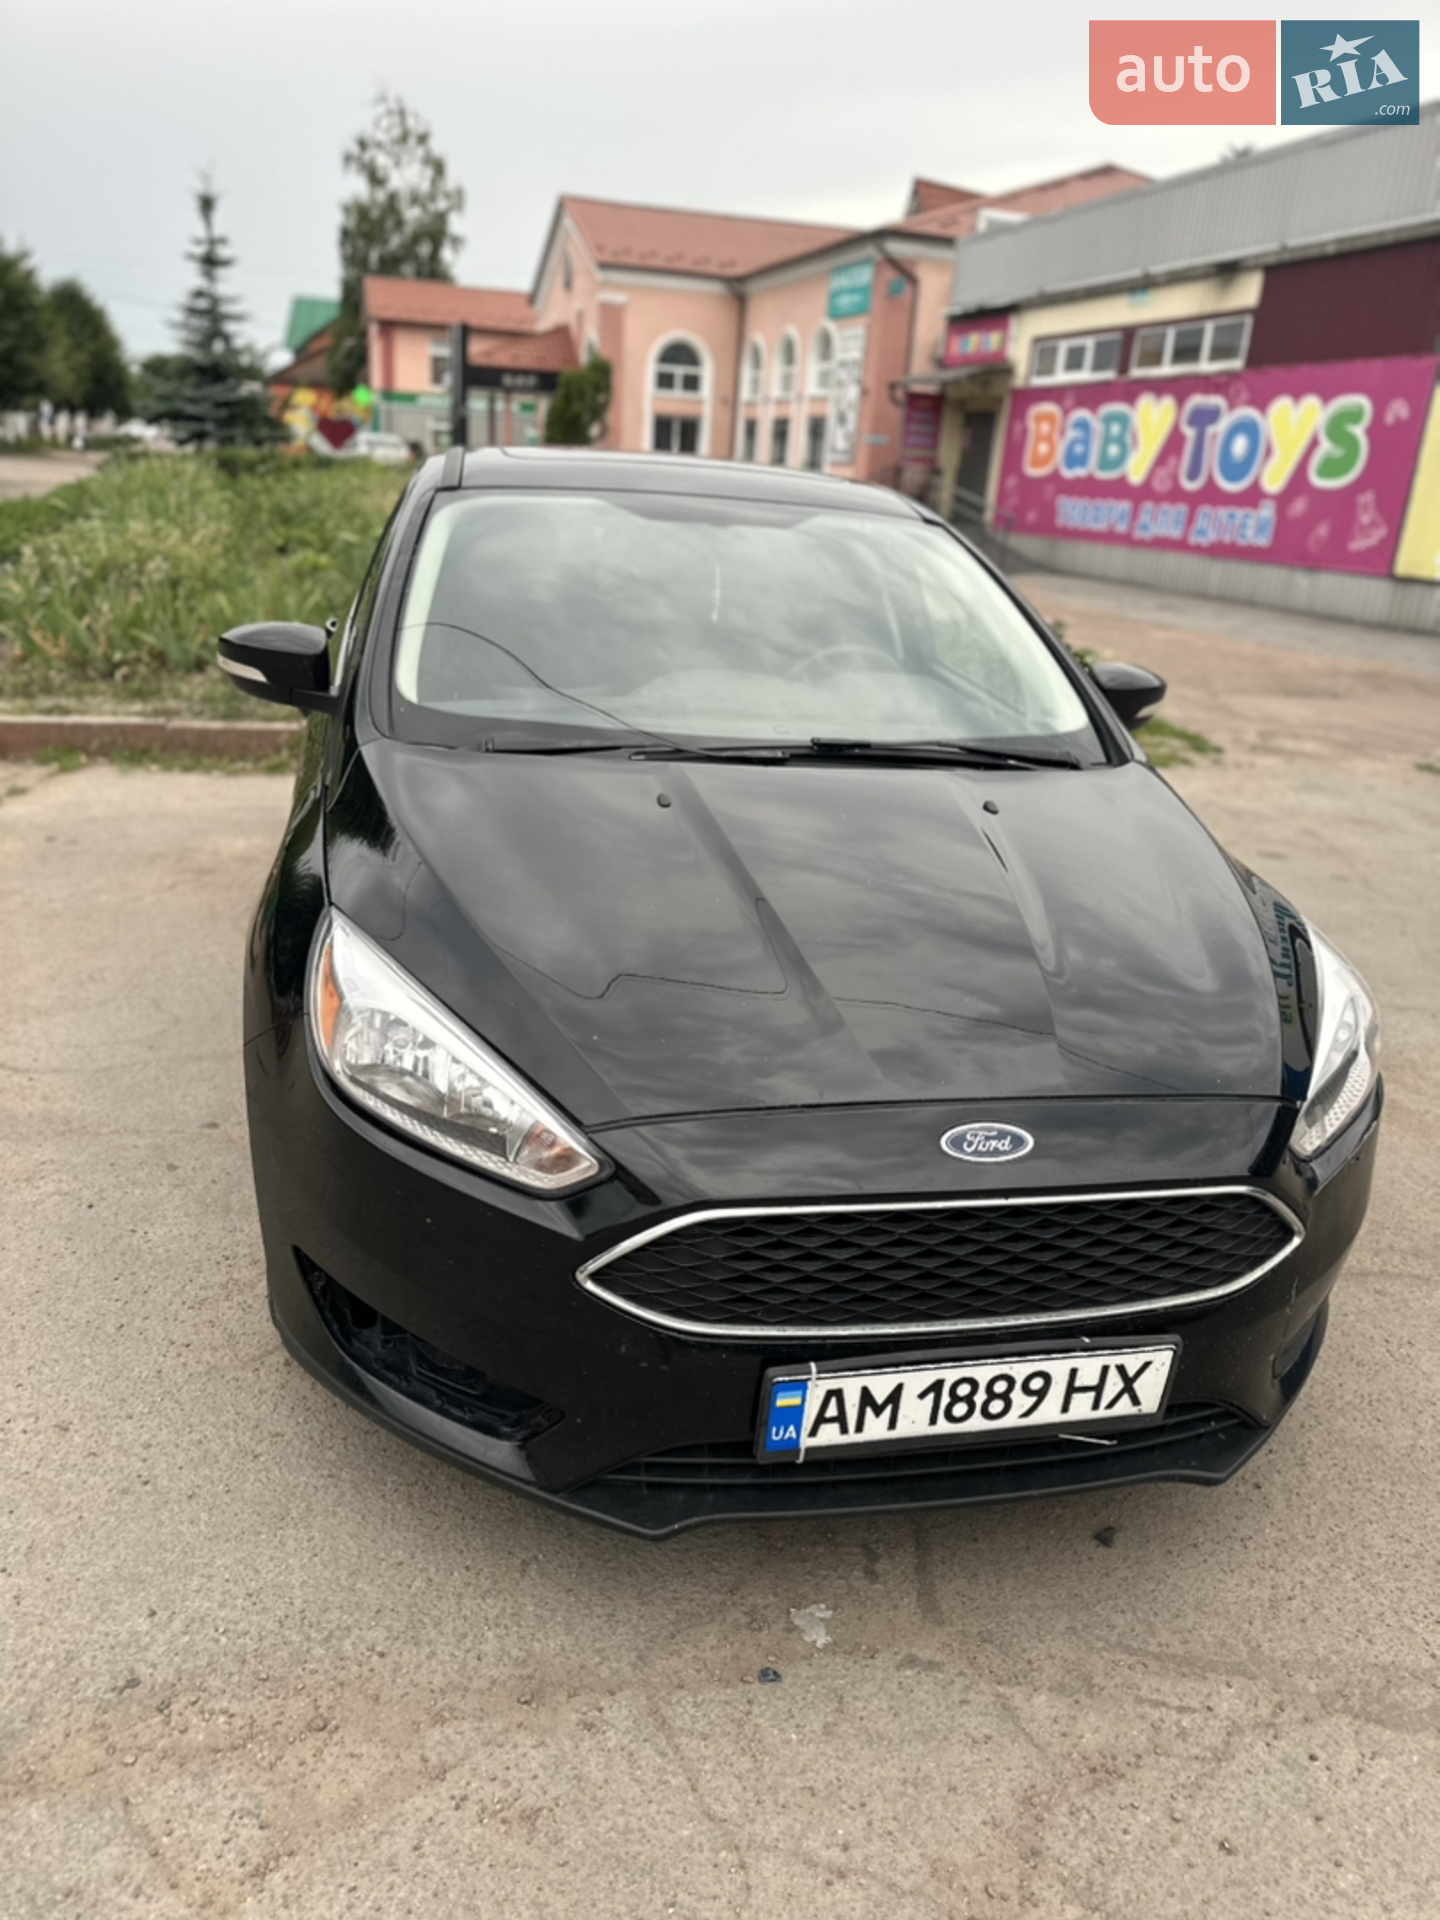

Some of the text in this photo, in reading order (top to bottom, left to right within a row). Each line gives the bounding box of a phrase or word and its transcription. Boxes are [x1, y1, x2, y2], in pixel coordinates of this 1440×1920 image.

[1133, 500, 1189, 541] ДЛЯ
[1189, 499, 1277, 547] ДІТЕЙ
[962, 1130, 1013, 1153] Ford
[807, 1360, 1153, 1438] AM 1889 HX
[771, 1425, 797, 1441] UA
